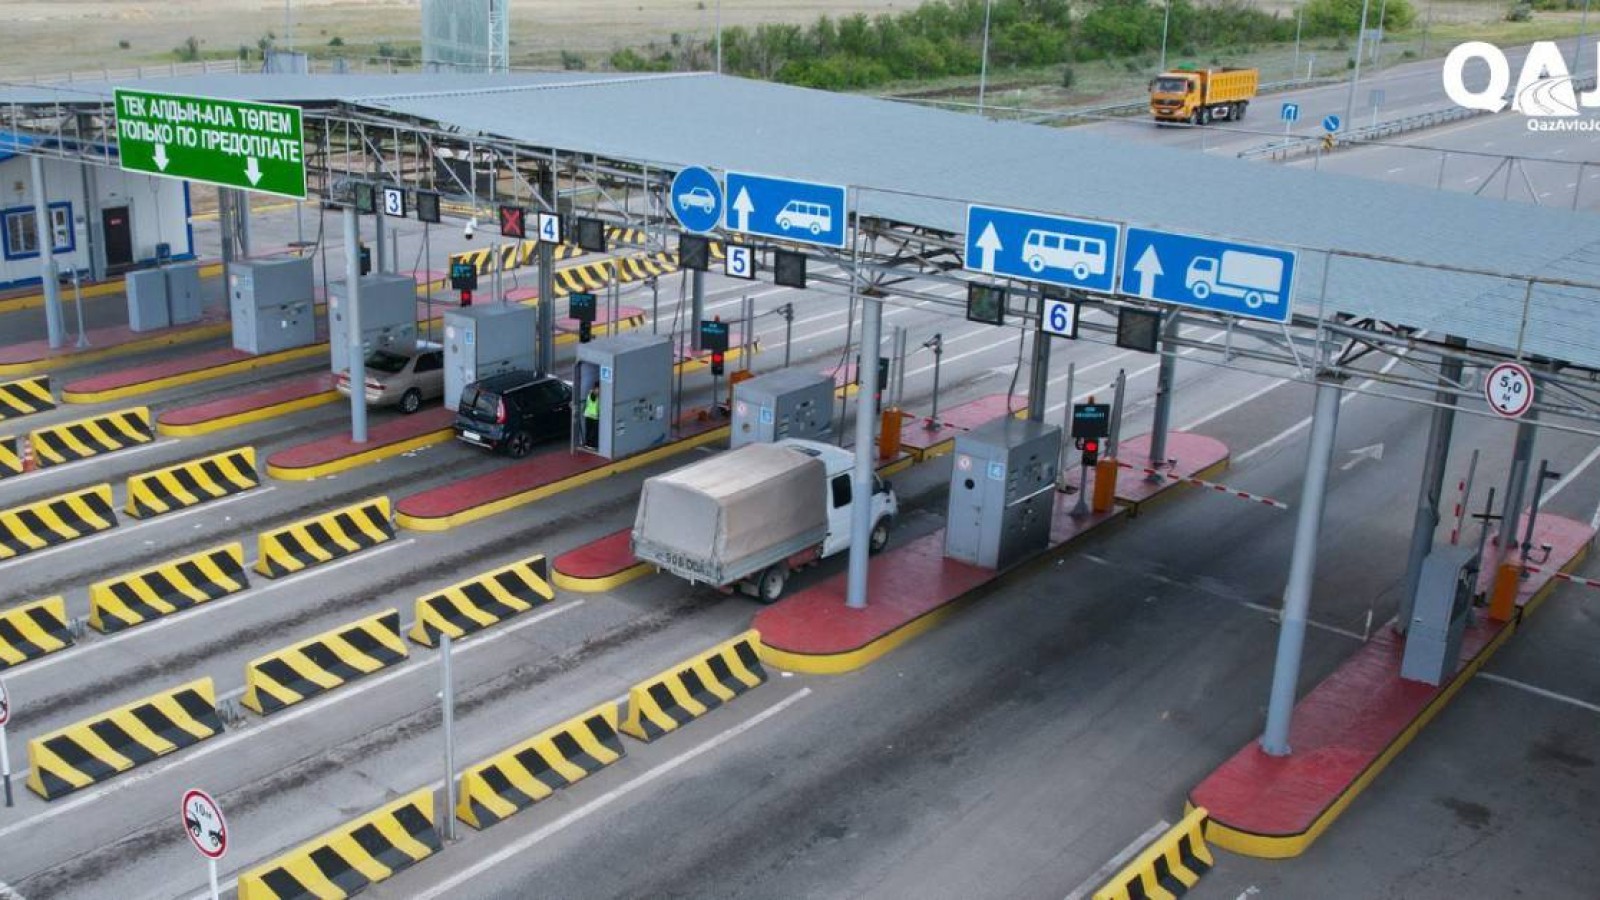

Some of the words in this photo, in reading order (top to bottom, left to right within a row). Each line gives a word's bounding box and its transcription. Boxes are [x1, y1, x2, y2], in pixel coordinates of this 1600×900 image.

[121, 95, 146, 117] ТЕК
[151, 99, 236, 127] АЛДЫН-АЛА
[238, 108, 292, 135] ТӨЛЕМ
[119, 119, 173, 144] ТОЛЬКО
[176, 126, 197, 147] ПО
[201, 129, 300, 163] ПРЕДОПЛАТЕ
[389, 191, 399, 213] 3
[543, 217, 554, 239] 4
[733, 249, 745, 273] 5
[1050, 303, 1067, 332] 6
